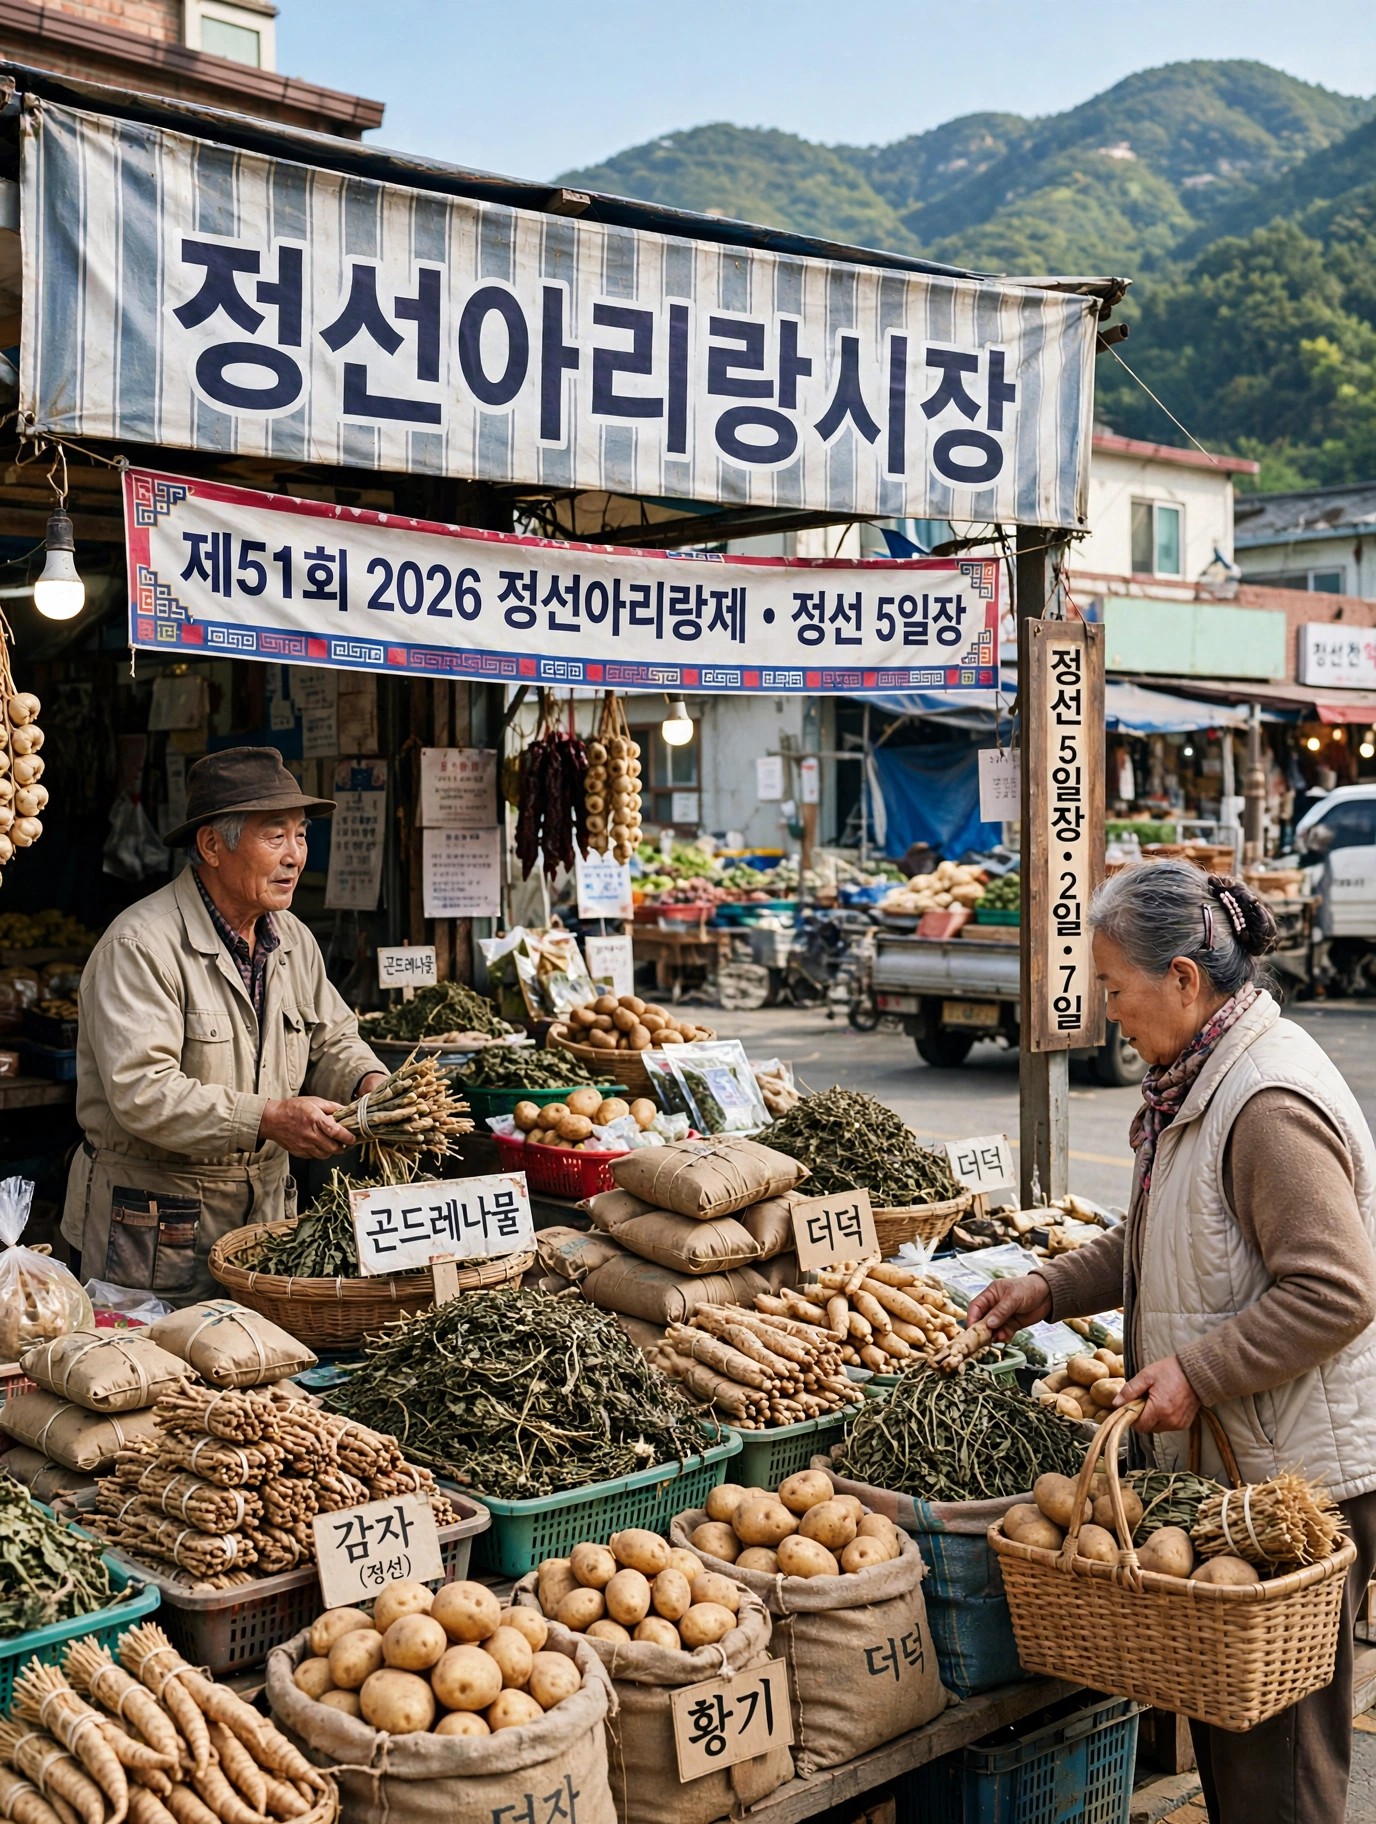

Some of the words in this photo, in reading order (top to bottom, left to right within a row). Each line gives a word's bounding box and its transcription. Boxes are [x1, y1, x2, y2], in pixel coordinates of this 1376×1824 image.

[173, 238, 1016, 485] 정선아리랑시장
[180, 531, 348, 611] 제51회
[366, 556, 482, 621] 2026
[497, 569, 747, 643] 정선아리랑제
[791, 589, 863, 645] 정선
[875, 593, 966, 646] 5일장
[1050, 648, 1081, 725] 정선
[1050, 735, 1085, 842] 5일장
[1052, 872, 1082, 936] 2일
[383, 955, 434, 976] 곤드레나물
[1053, 965, 1082, 1030] 7일
[957, 1145, 1004, 1181] 더덕
[366, 1191, 520, 1254] 곤드레나물
[806, 1204, 863, 1251] 더덕
[333, 1505, 414, 1564] 감자
[359, 1553, 411, 1589] (정선)
[863, 1622, 925, 1682] 더덕
[687, 1678, 774, 1757] 황기
